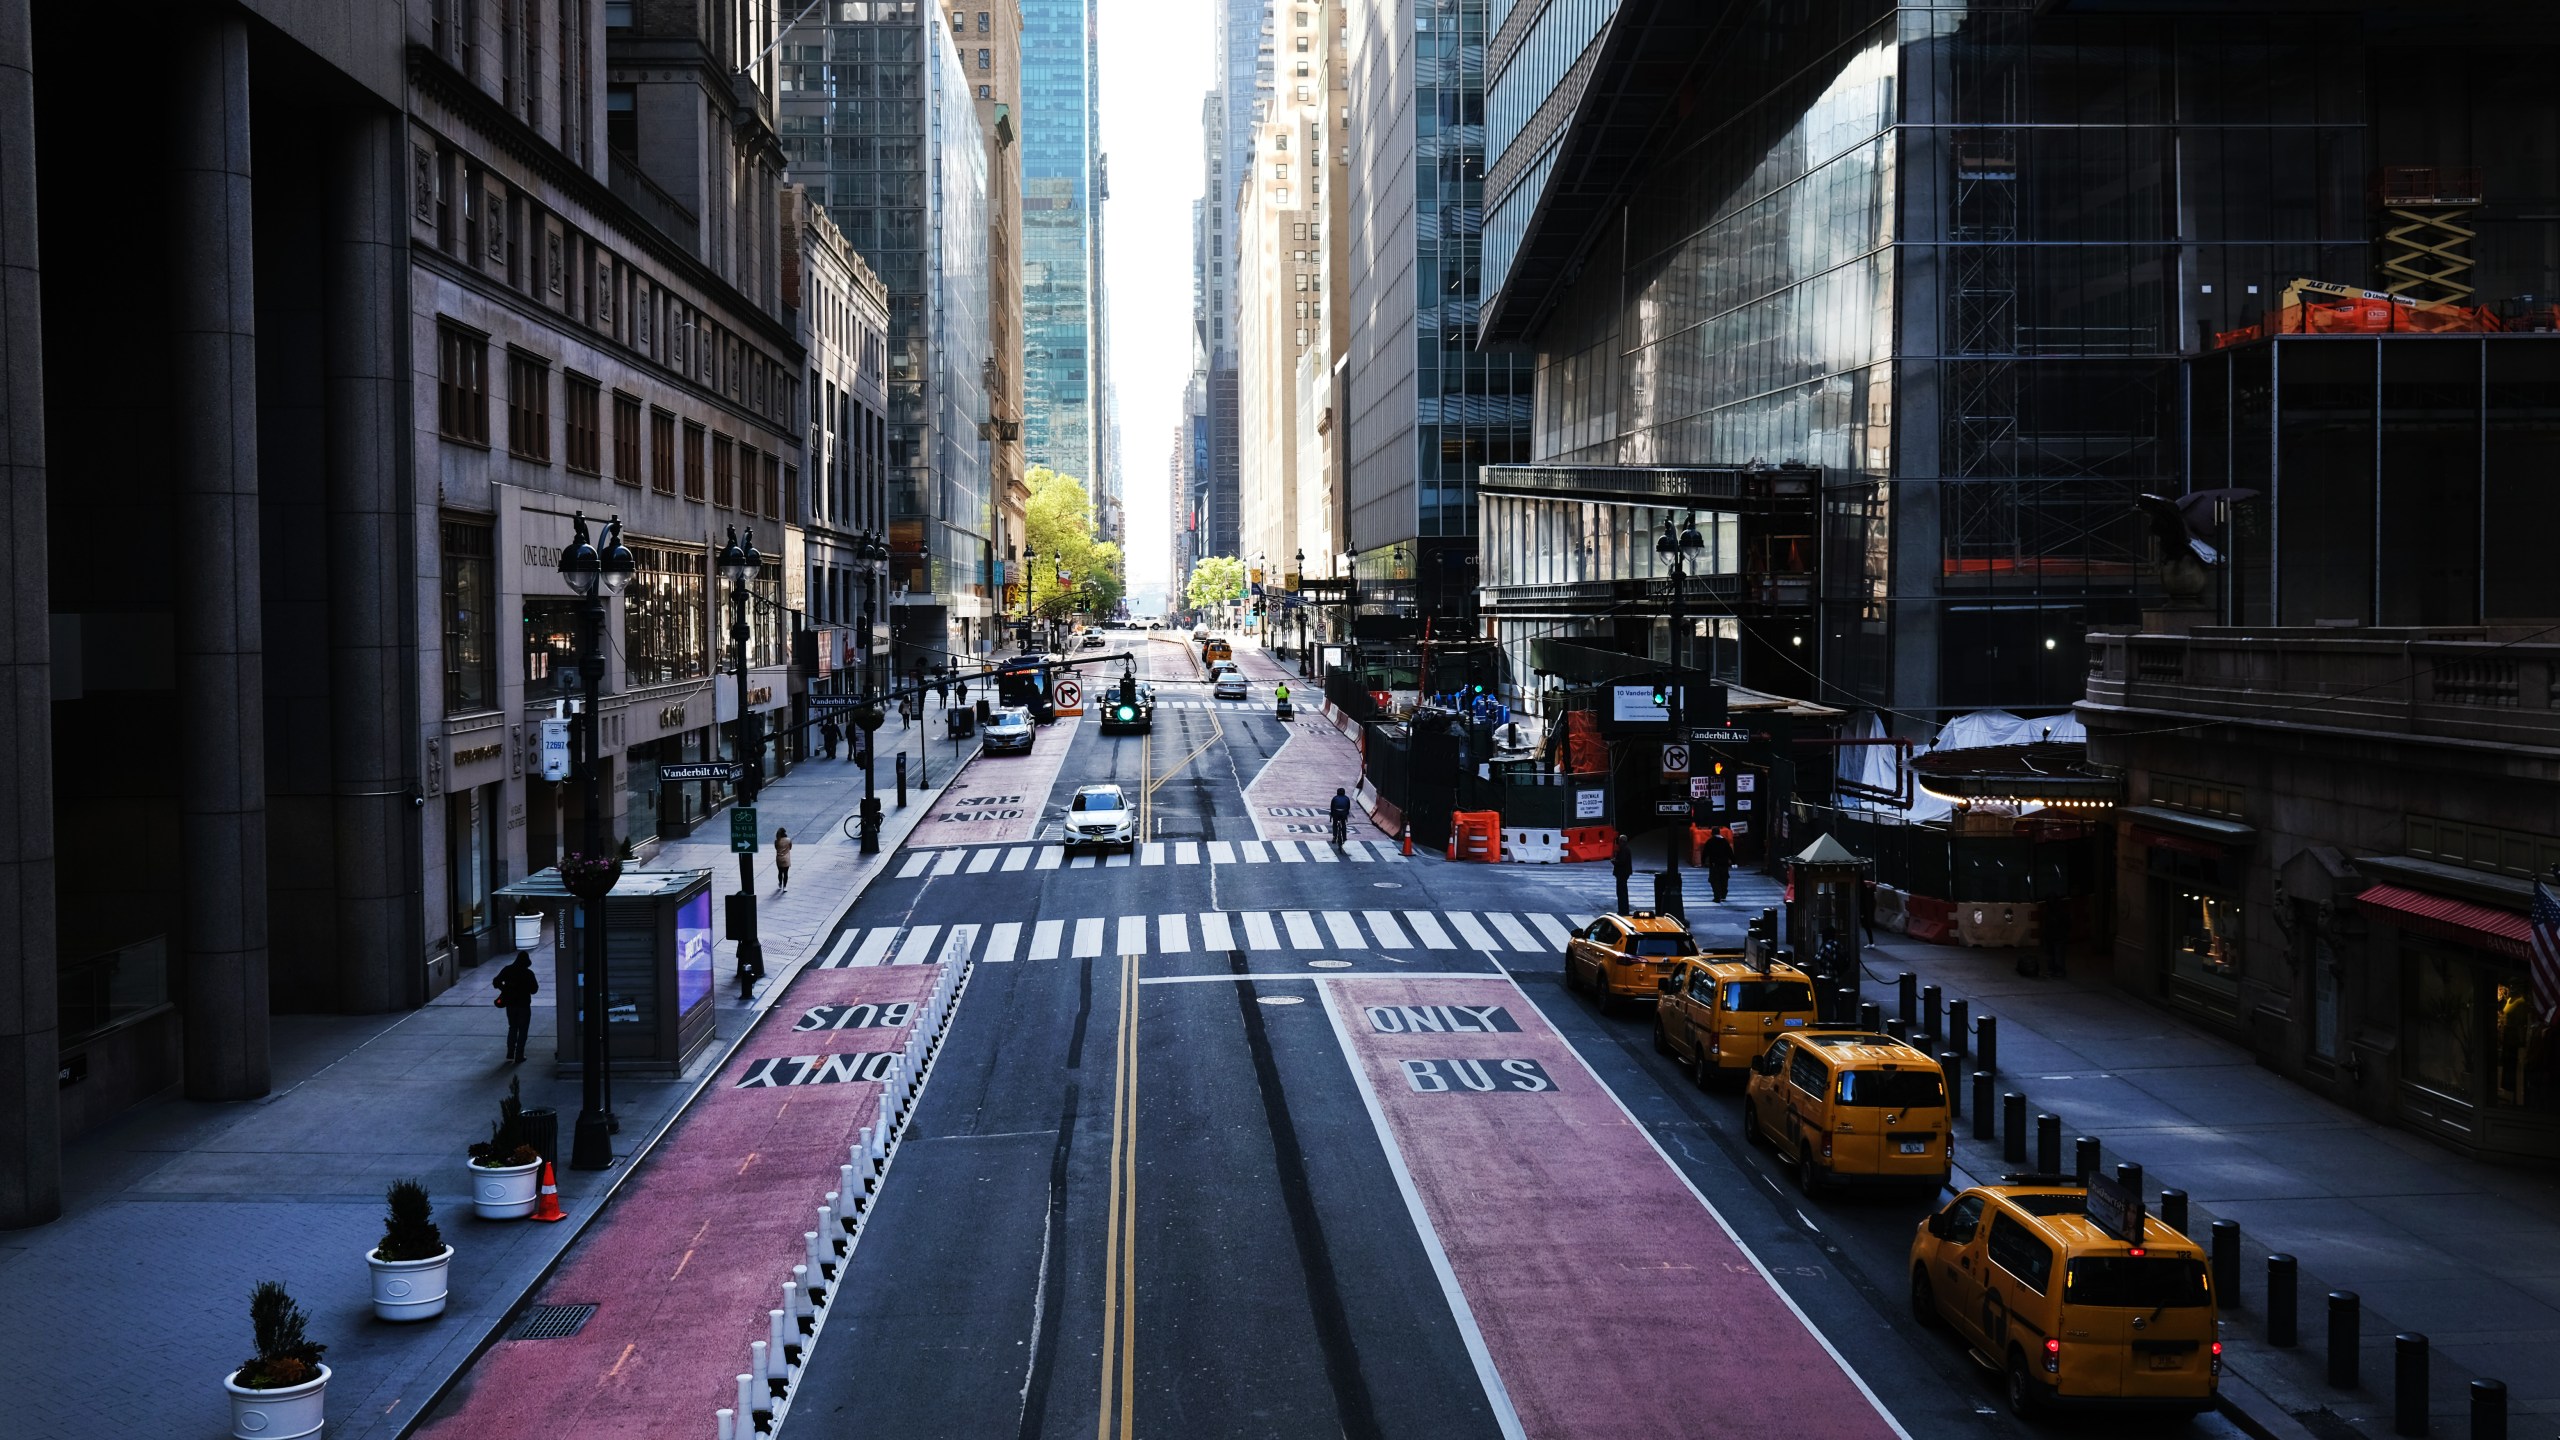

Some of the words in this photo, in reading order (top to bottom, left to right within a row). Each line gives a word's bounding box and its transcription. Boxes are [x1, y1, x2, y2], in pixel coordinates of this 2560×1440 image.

[2325, 283, 2345, 293] LIFT
[2372, 292, 2388, 300] Unite
[524, 544, 538, 566] ONE
[811, 697, 844, 705] Vanderbilt
[1732, 732, 1748, 740] Ave
[546, 741, 565, 749] 72697
[663, 768, 710, 777] Vanderbilt
[956, 796, 1021, 806] BUS
[941, 810, 1022, 822] ONLY
[1269, 808, 1332, 817] ONL
[2488, 935, 2525, 958] BANANA
[792, 1002, 918, 1032] BUS
[1364, 1006, 1501, 1033] ONLY
[734, 1051, 902, 1089] ONLY
[1400, 1060, 1547, 1092] BUS
